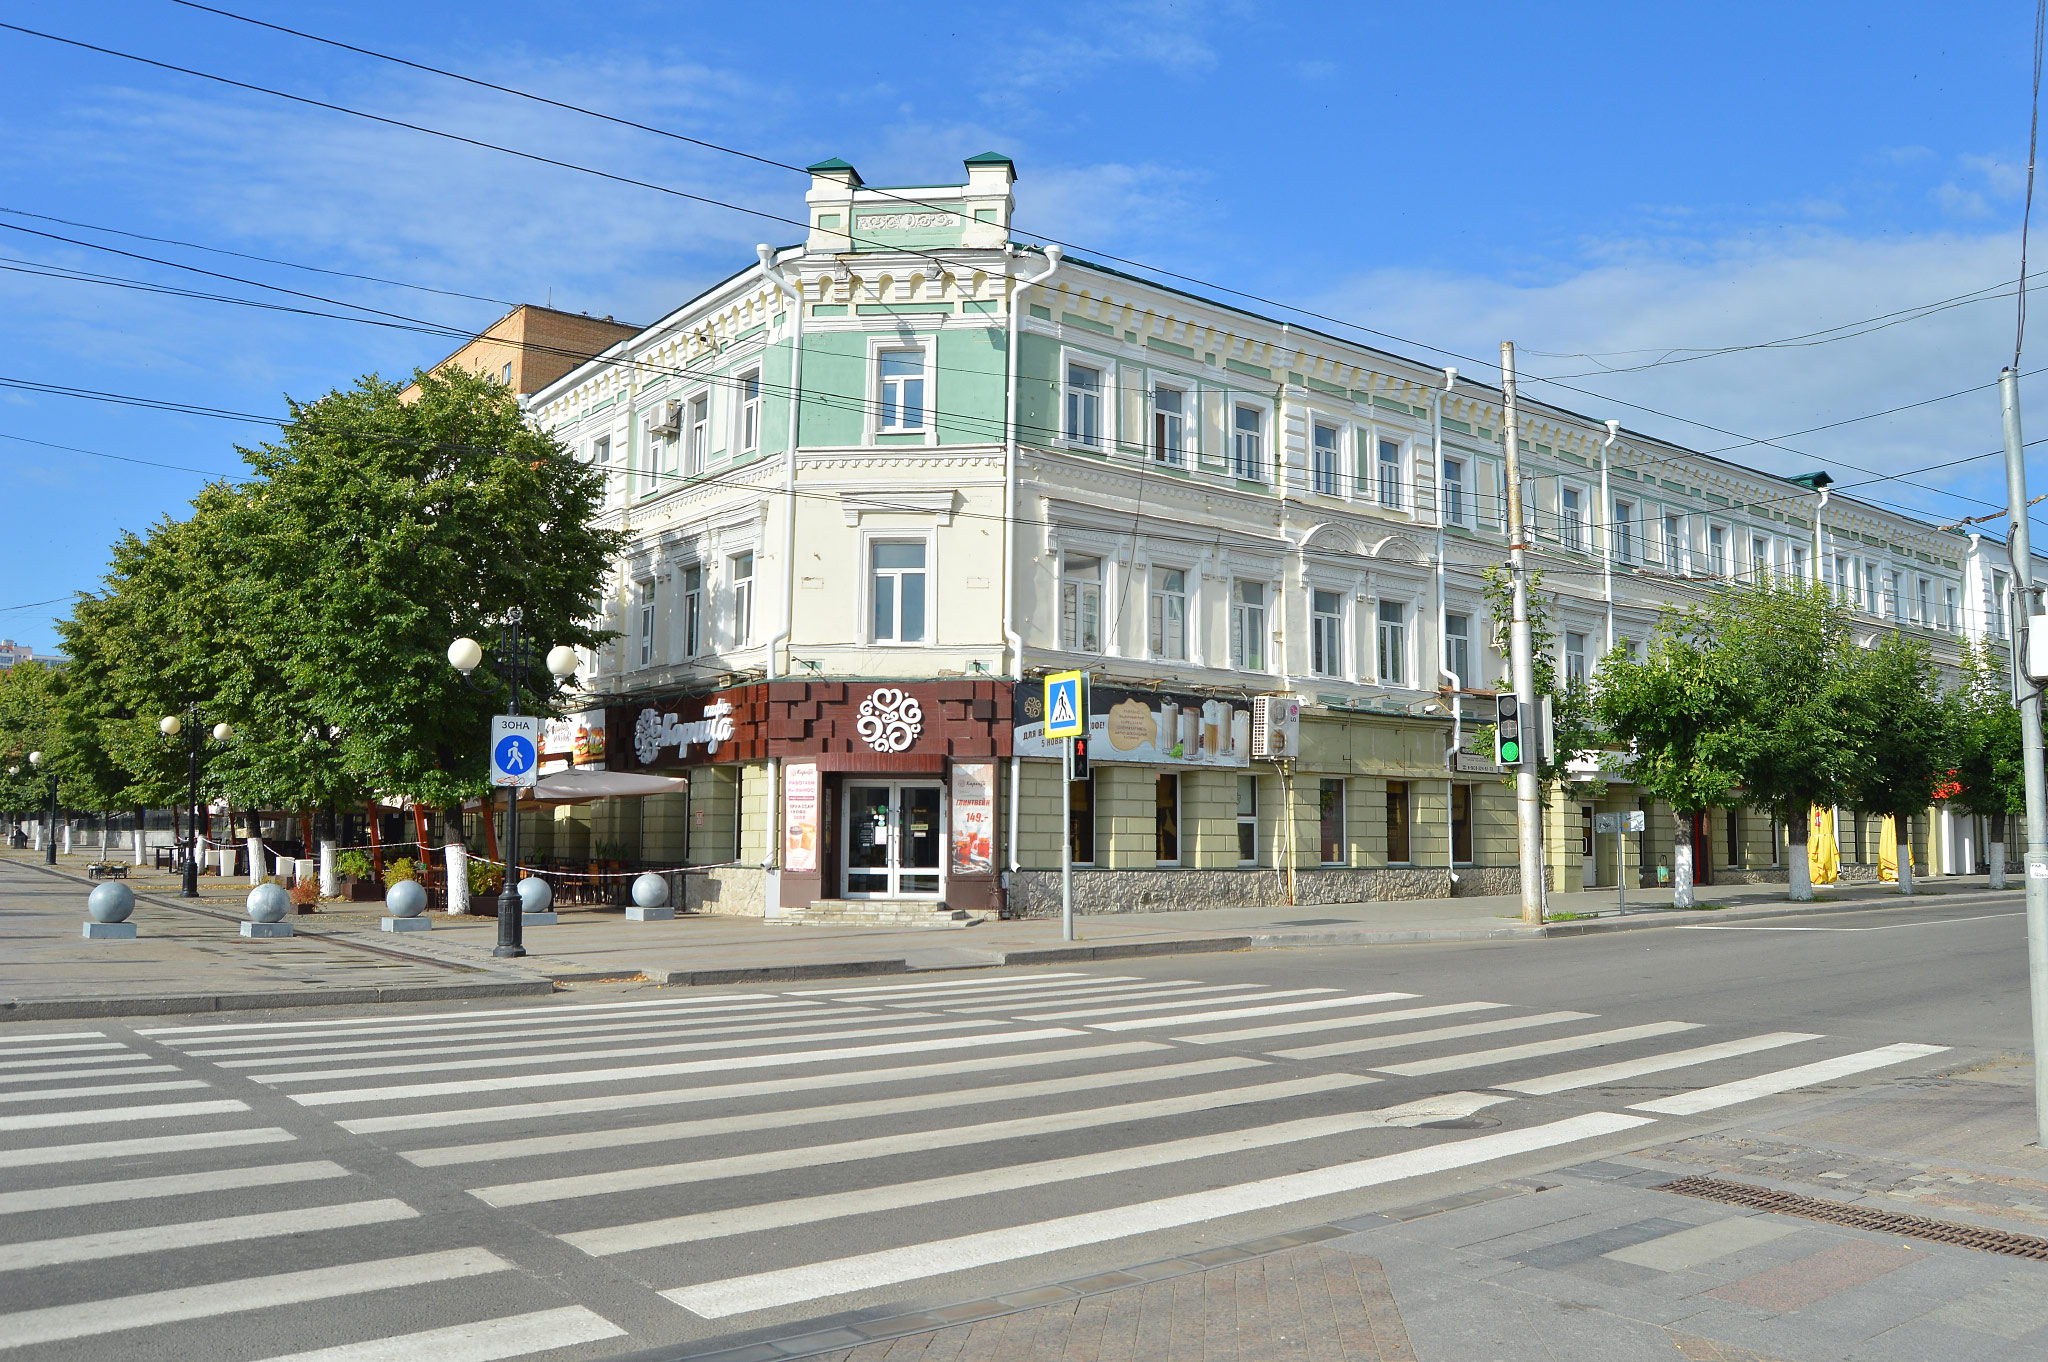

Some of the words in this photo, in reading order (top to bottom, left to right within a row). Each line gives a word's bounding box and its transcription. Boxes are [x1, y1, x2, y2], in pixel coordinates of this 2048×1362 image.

[501, 720, 530, 730] ЗОНА
[1023, 729, 1036, 741] ДЛЯ
[1091, 721, 1105, 730] ОФЕ!
[1041, 740, 1045, 748] 5
[1046, 737, 1064, 746] НОВЫ
[966, 812, 989, 823] 149.-
